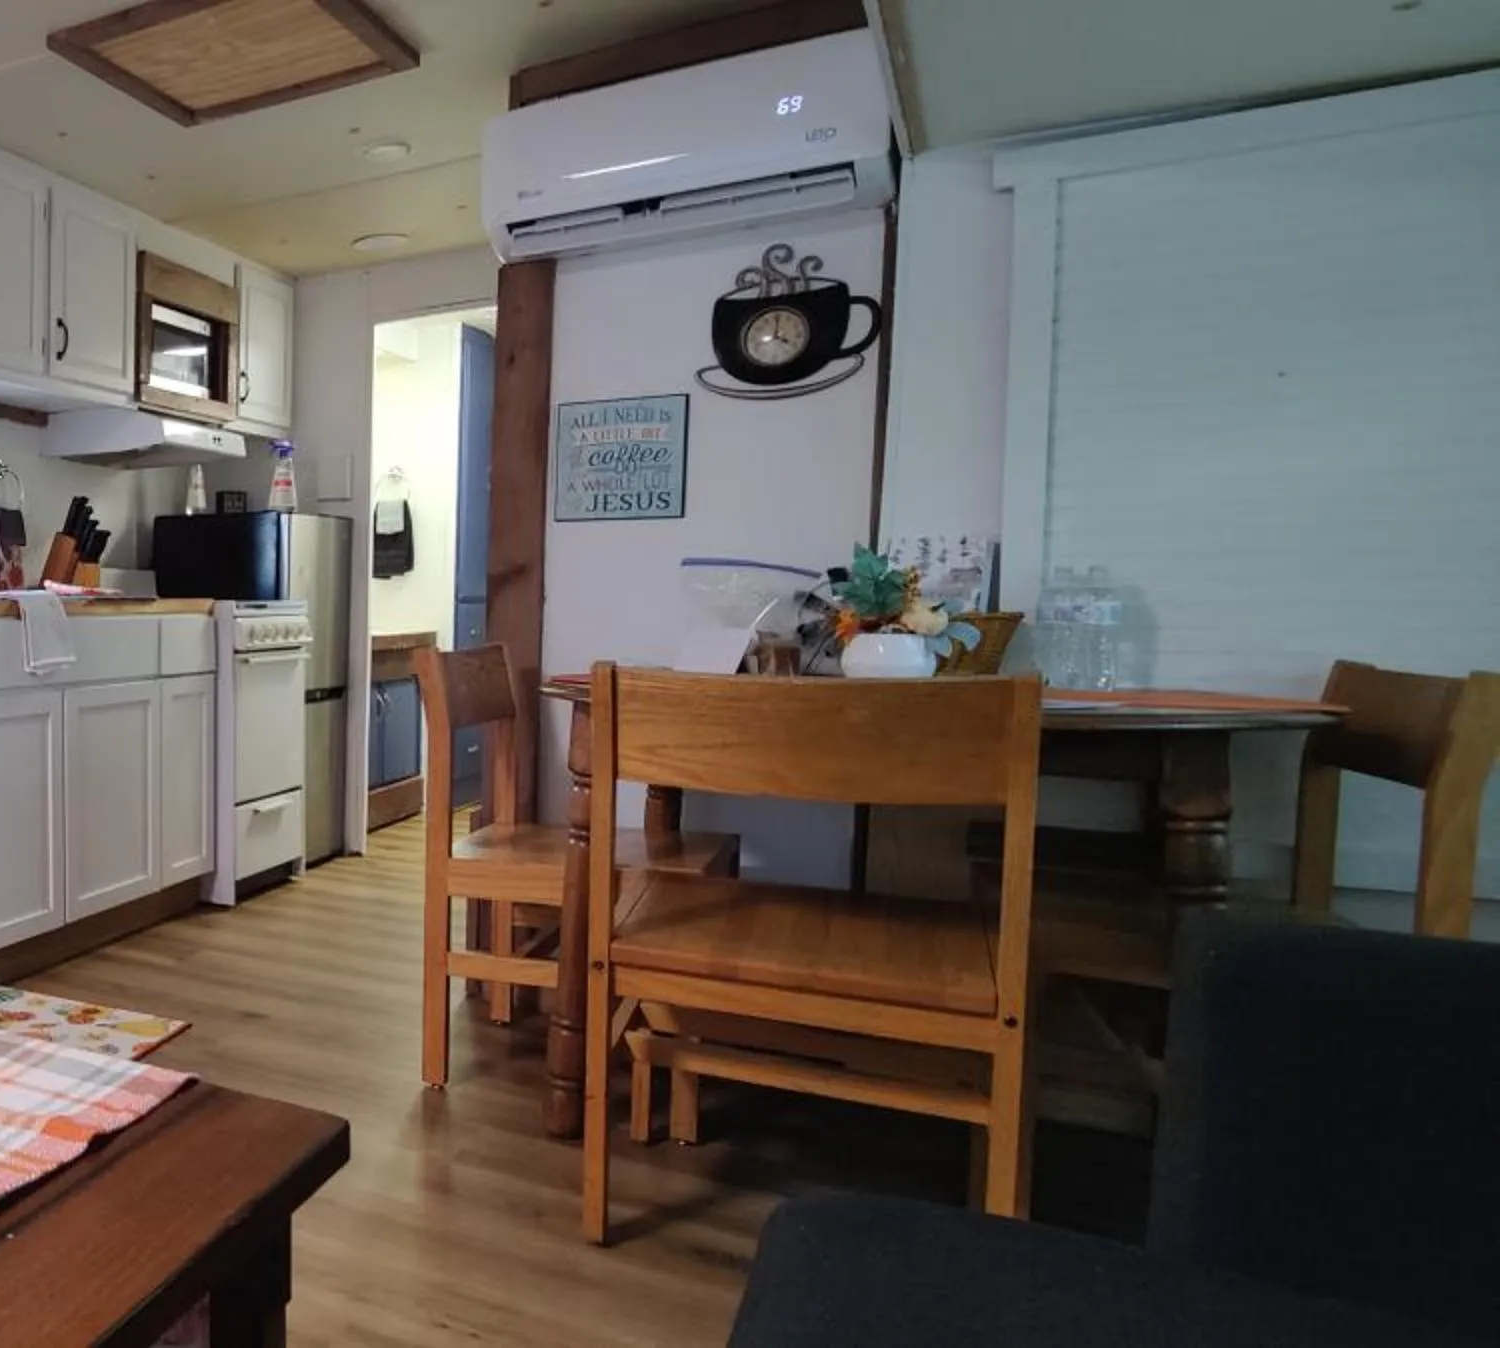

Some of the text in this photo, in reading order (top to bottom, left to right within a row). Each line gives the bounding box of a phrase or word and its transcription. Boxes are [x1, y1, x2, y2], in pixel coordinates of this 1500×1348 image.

[777, 95, 803, 115] 69
[570, 413, 598, 429] ALL
[614, 406, 654, 422] NEED
[588, 443, 672, 474] coffee
[585, 491, 671, 512] JESUS
